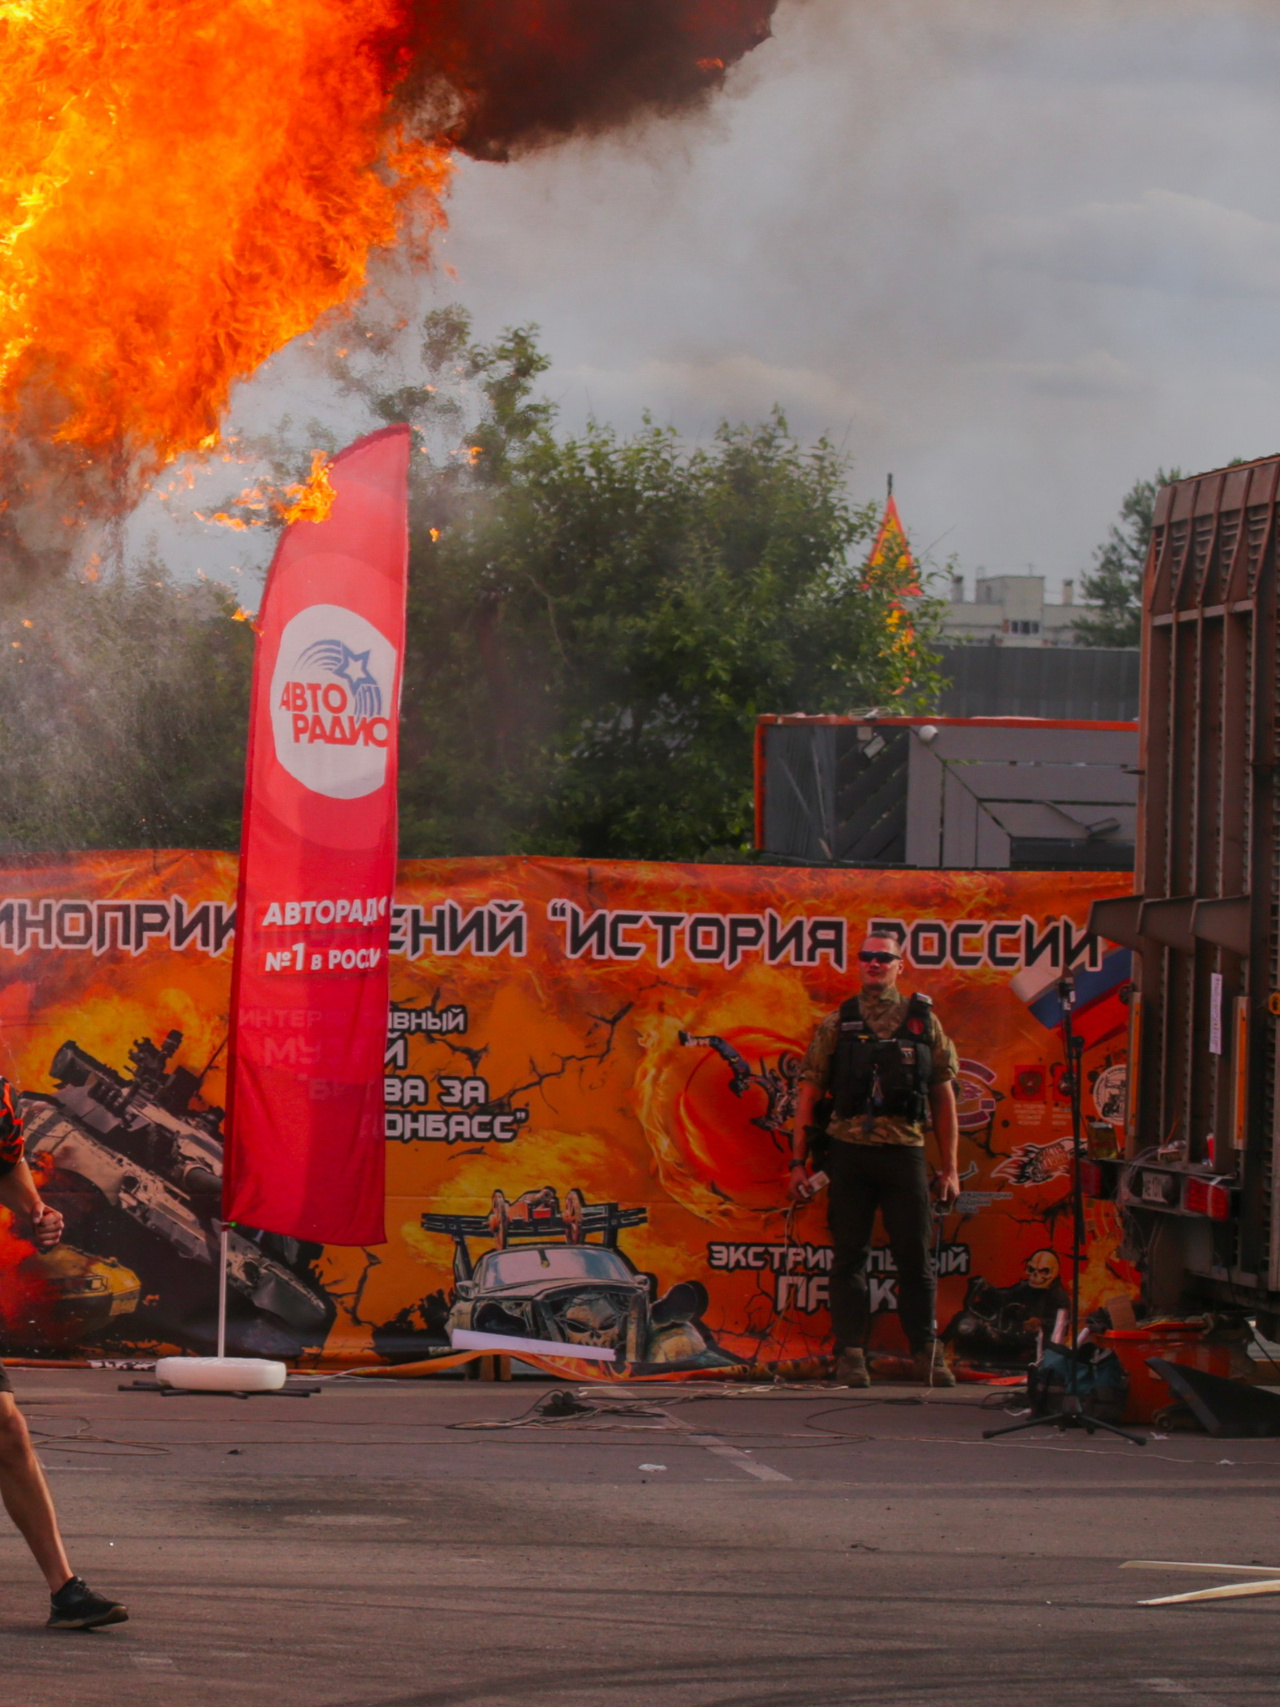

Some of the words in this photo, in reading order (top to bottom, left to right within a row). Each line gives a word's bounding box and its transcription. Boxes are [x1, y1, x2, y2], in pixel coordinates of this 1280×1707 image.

[279, 681, 348, 714] АВТО
[292, 713, 391, 748] РАДИО
[439, 1078, 485, 1106] ЗА
[360, 1111, 527, 1142] ОНБАСС”
[776, 1274, 898, 1314] ПАК
